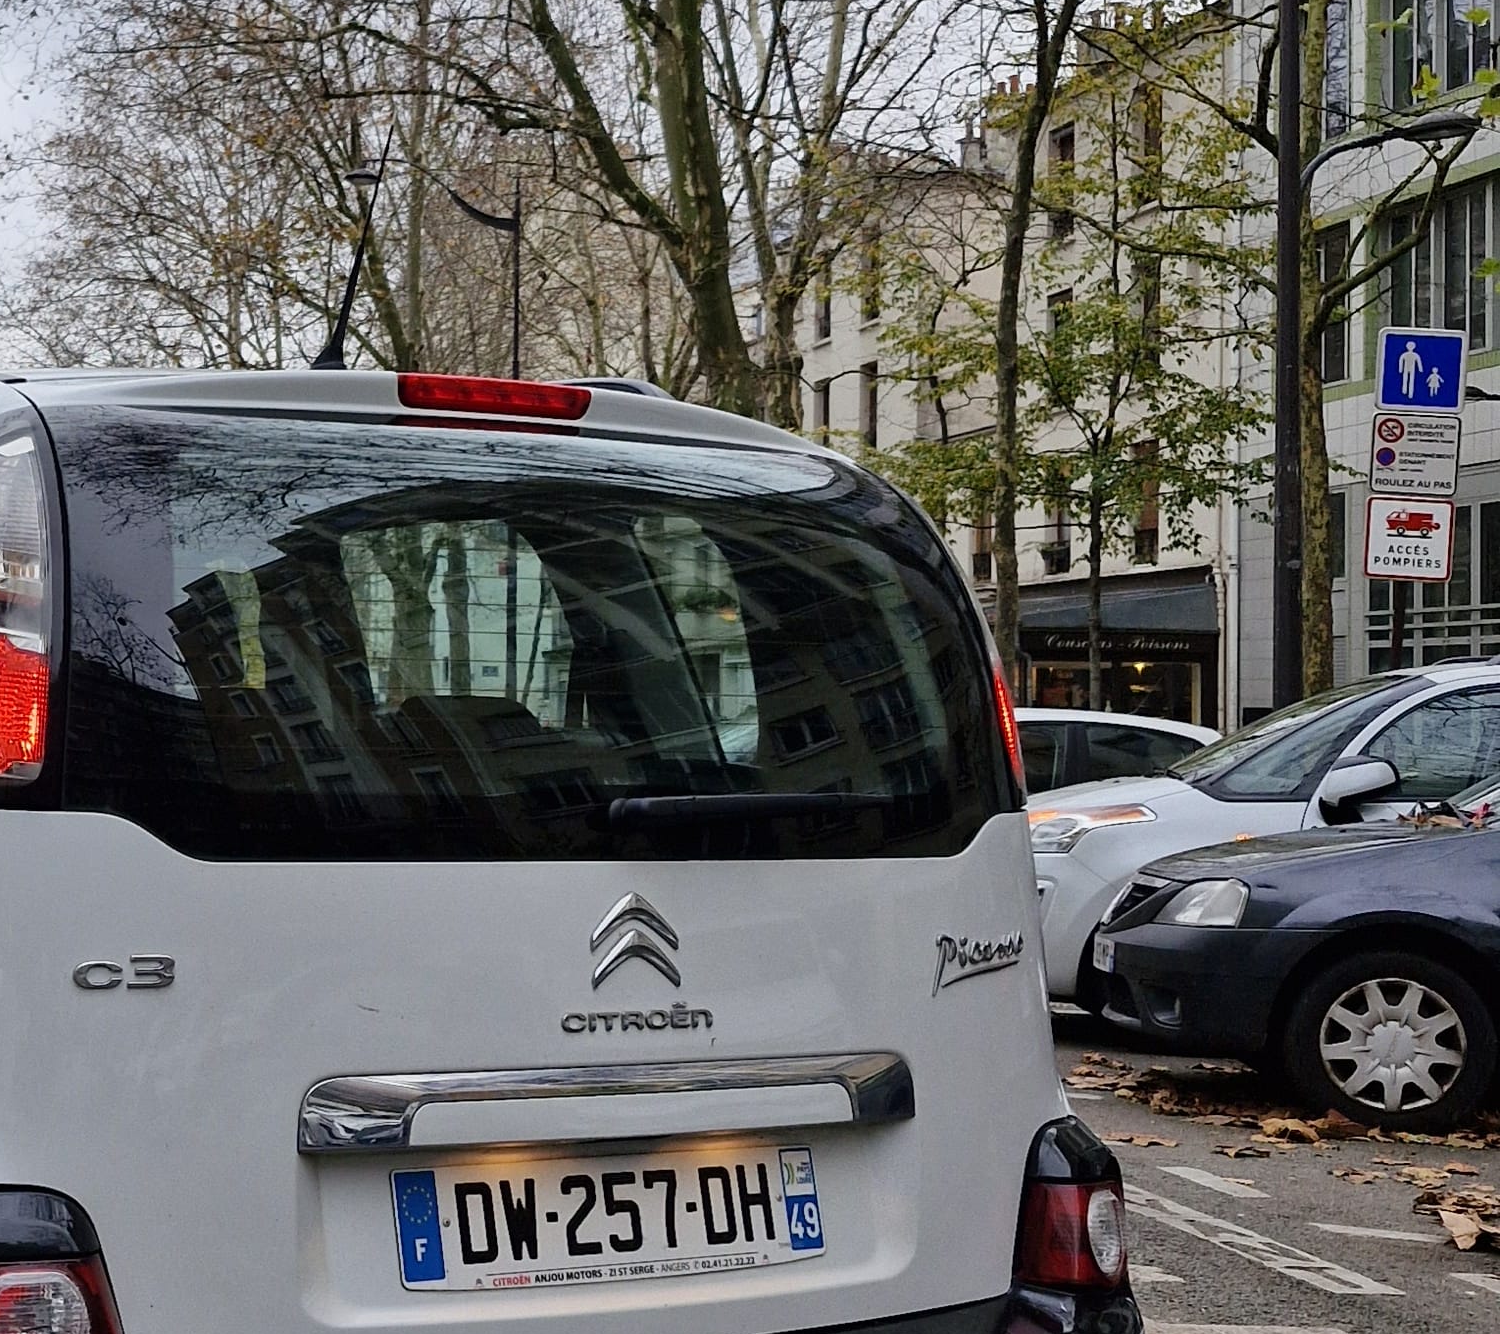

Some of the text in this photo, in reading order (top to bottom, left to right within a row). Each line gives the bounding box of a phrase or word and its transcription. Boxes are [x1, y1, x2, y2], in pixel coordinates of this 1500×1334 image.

[1374, 478, 1415, 487] ROULEZ
[1434, 481, 1453, 489] PAS
[1373, 556, 1442, 569] POMPIERS
[1044, 634, 1113, 649] Couscus
[73, 953, 176, 990] C3
[454, 1163, 776, 1265] DW-257-DH
[791, 1201, 821, 1240] 49
[414, 1238, 428, 1262] F
[492, 1274, 532, 1287] CITROËN
[534, 1272, 565, 1283] ANJOU
[566, 1269, 603, 1281] MOTORS
[608, 1268, 617, 1277] ZI
[618, 1267, 627, 1276] ST
[630, 1265, 655, 1275] SERGE
[660, 1261, 691, 1273] ANGERS
